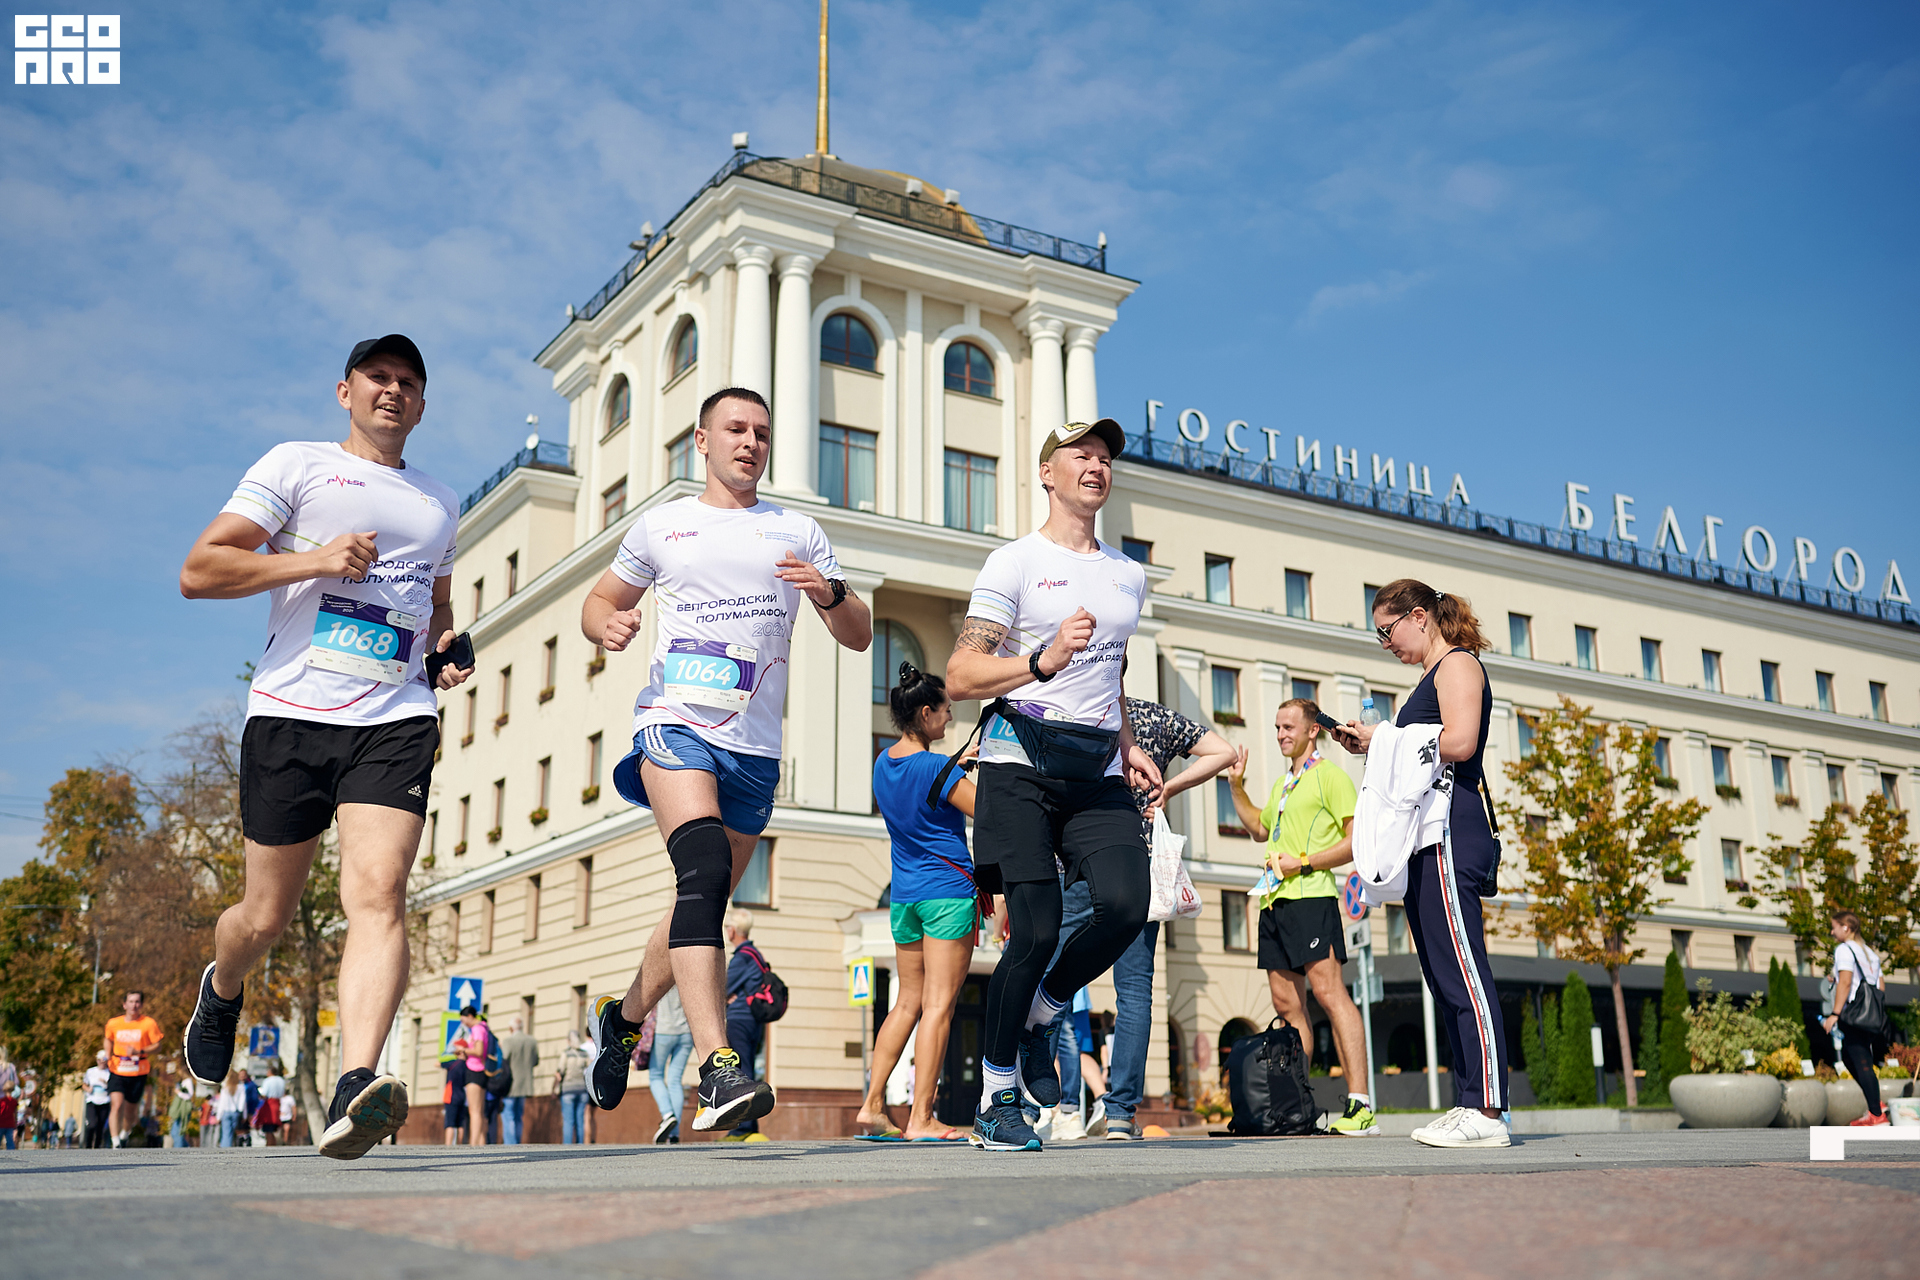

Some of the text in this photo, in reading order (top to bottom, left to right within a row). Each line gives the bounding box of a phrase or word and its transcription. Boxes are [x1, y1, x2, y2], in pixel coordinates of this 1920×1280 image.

[1146, 399, 1912, 605] ГОСТИНИЦА БЕЛГОРОД
[676, 593, 777, 612] БЕЛГОРОДСКИЙ
[696, 608, 787, 624] ПОЛУМАРАФОН
[327, 621, 393, 655] 1068
[752, 621, 786, 638] 2021
[675, 659, 732, 685] 1064
[998, 719, 1015, 737] 10
